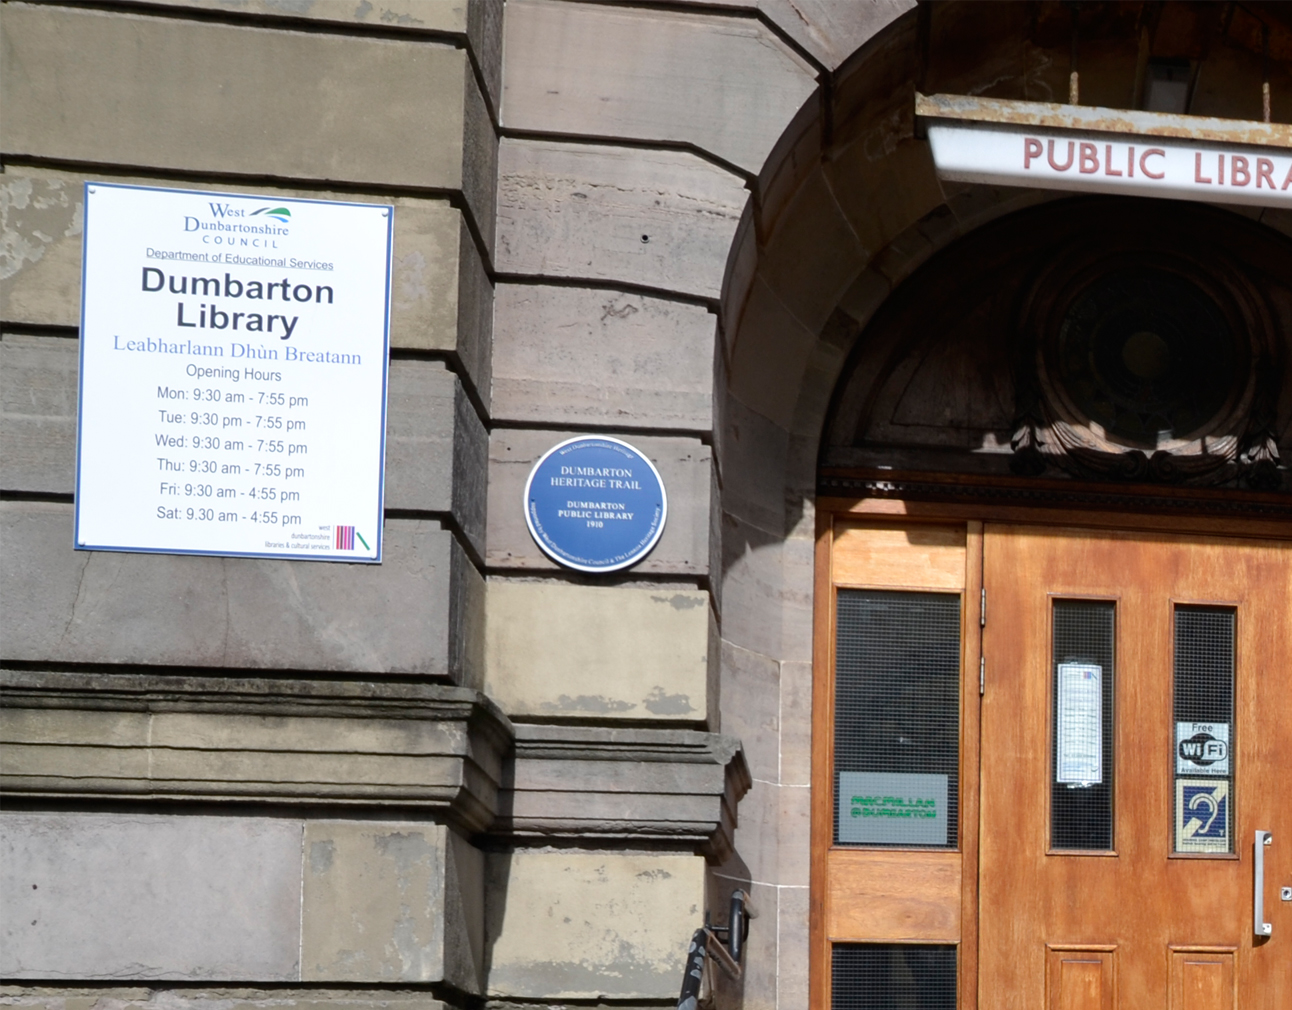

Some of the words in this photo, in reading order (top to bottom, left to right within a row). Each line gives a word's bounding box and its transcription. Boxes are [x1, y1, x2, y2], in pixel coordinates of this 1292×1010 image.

[1022, 136, 1166, 179] PUBLIC
[208, 201, 245, 218] West
[183, 215, 289, 236] Dunbartonshire
[202, 234, 278, 249] COUNCIL
[146, 247, 209, 261] Department
[212, 253, 223, 263] of
[225, 253, 286, 268] Educational
[289, 258, 334, 271] Services
[141, 266, 334, 304] Dumbarton
[176, 302, 299, 340] Library
[112, 335, 225, 357] Leabharlann
[230, 343, 278, 361] Dhùn
[285, 346, 362, 365] Breatann
[186, 363, 240, 382] Opening
[244, 367, 282, 382] Hours
[157, 386, 189, 401] Mon:
[193, 388, 221, 403] 9:30
[224, 392, 245, 403] am
[257, 391, 285, 406] 7:55
[289, 395, 309, 409] pm
[158, 410, 186, 425] Tue:
[190, 412, 219, 427] 9:30
[222, 416, 242, 429] pm
[255, 415, 283, 430] 7:55
[286, 419, 306, 432] pm
[155, 433, 188, 449] Wed:
[192, 436, 221, 451] 9:30
[224, 440, 244, 451] am
[256, 439, 284, 454] 7:55
[288, 442, 308, 456] pm
[156, 458, 185, 472] Thu:
[189, 460, 218, 474] 9:30
[221, 464, 241, 475] am
[253, 463, 281, 477] 7:55
[285, 466, 305, 480] pm
[560, 465, 633, 478] DUMBARTON
[159, 482, 181, 496] Fri:
[184, 484, 213, 499] 9:30
[216, 487, 237, 499] am
[248, 487, 277, 501] 4:55
[280, 490, 300, 504] pm
[550, 477, 607, 488] HERITAGE
[608, 479, 642, 490] TRAIL
[557, 509, 593, 519] PUBLIC
[594, 511, 634, 521] LIBRARY
[566, 500, 626, 510] DUMBARTON
[156, 506, 182, 520] Sat:
[186, 507, 214, 522] 9.30
[218, 511, 238, 522] am
[250, 511, 278, 525] 4:55
[282, 514, 302, 527] pm
[290, 533, 331, 541] dunbartonshire
[1191, 723, 1214, 732] Free
[850, 795, 936, 808] MACMILLAN
[850, 807, 937, 819] @DUMBARTON
